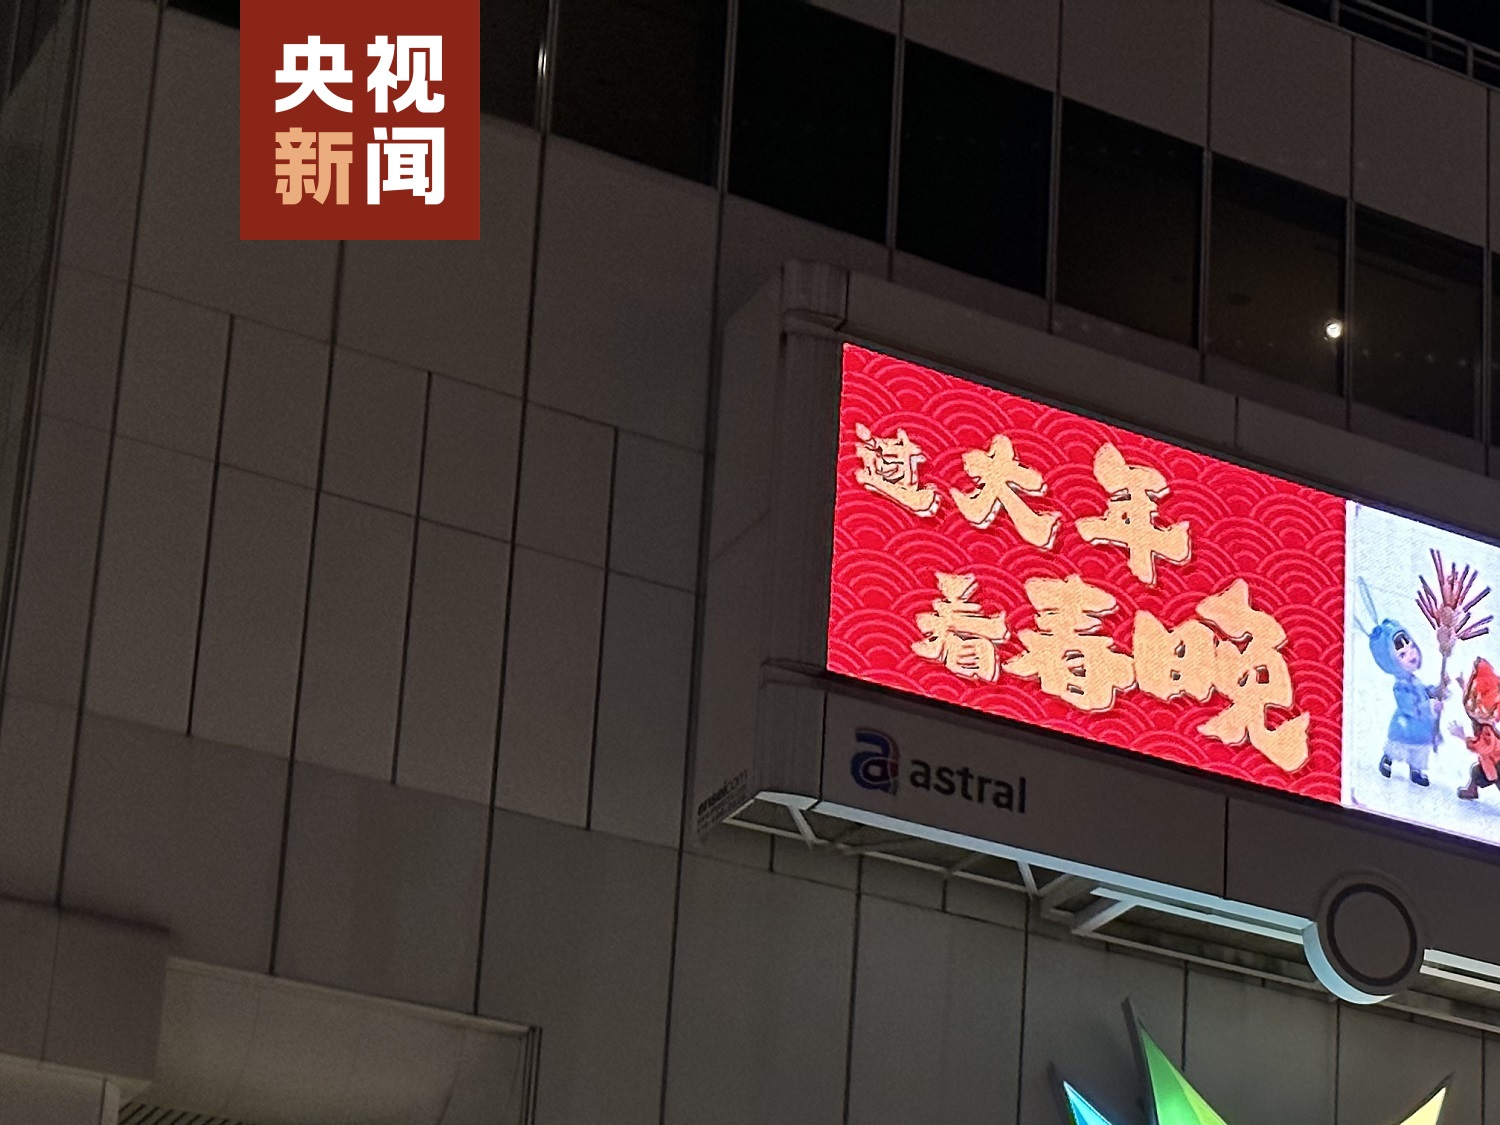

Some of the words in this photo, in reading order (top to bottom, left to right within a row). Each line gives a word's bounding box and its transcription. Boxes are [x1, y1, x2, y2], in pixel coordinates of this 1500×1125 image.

[855, 421, 1192, 585] 过大年
[911, 572, 1311, 773] 看春晚
[909, 758, 1027, 814] astral
